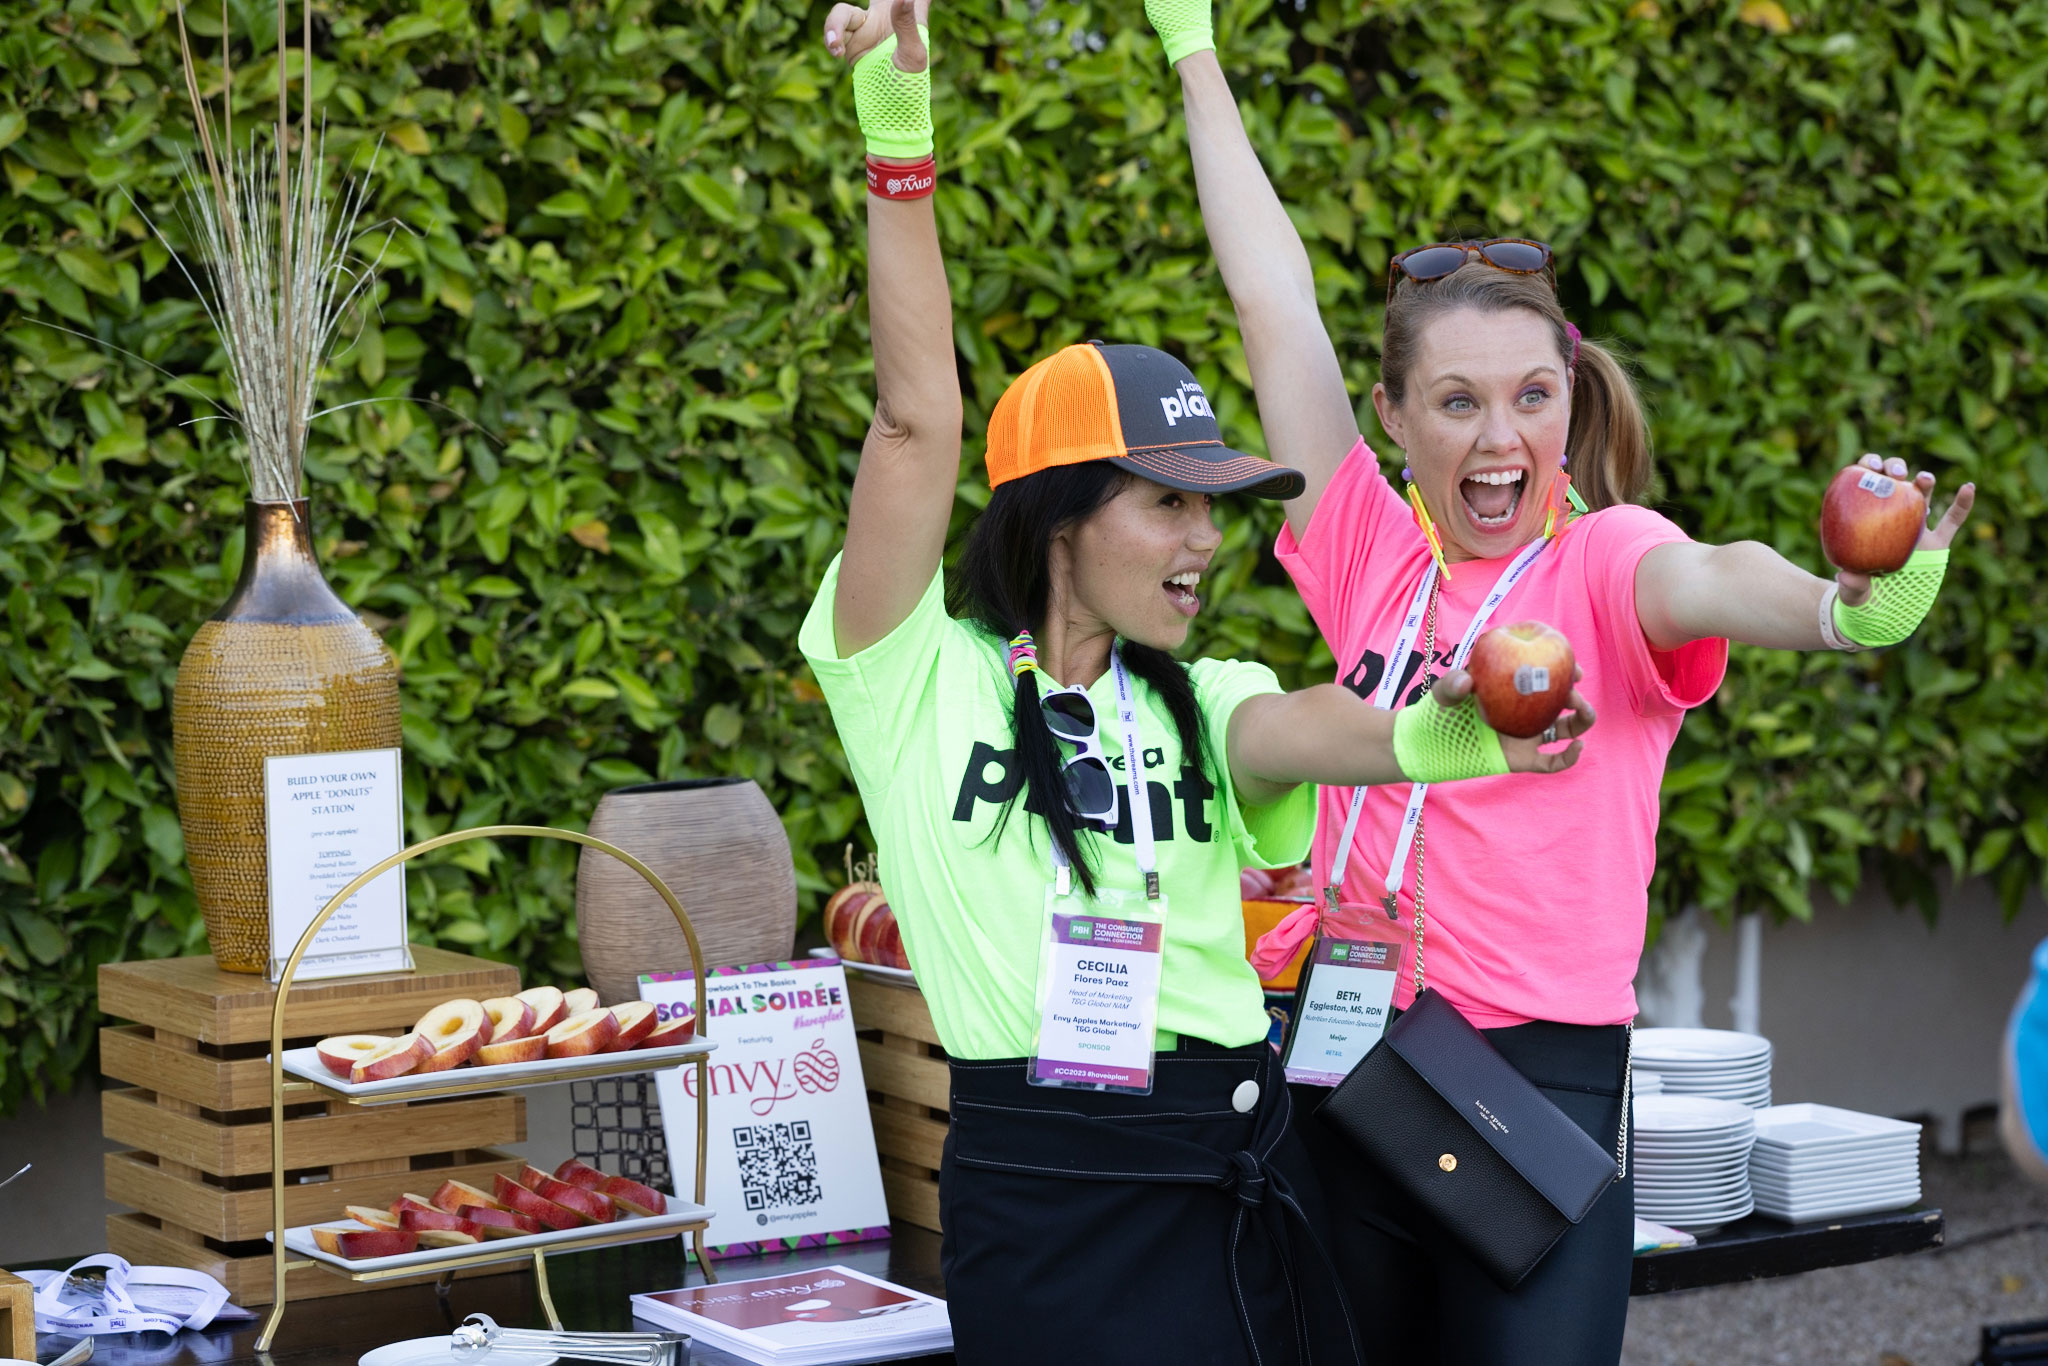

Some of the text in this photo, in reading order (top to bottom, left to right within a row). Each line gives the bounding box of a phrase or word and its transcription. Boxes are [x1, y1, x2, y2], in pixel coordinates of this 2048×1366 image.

[287, 771, 377, 786] BUILD YOUR OWN
[292, 791, 321, 801] APPLE
[311, 804, 355, 815] STATION
[318, 850, 351, 859] TOPPINGS
[1072, 922, 1144, 935] PBH THE CONSUMER
[1094, 929, 1143, 940] CONNECTION
[1349, 951, 1386, 960] CONNECTION
[1077, 960, 1128, 975] CECILIA
[694, 978, 796, 994] owback To The Basics
[1074, 973, 1129, 988] Flores Paez
[752, 982, 842, 1013] SOIRÉE
[1069, 989, 1133, 1003] Head of Marketing
[1336, 991, 1361, 1002] BETH
[1087, 998, 1113, 1009] Global
[1309, 1001, 1382, 1016] Eggleston, MS, RDN
[793, 1008, 845, 1031] #haveaplant
[1053, 1014, 1141, 1030] Envy Apples Marketing/
[1304, 1014, 1382, 1029] Nutrition Education Specialist
[1092, 1026, 1117, 1036] Global
[738, 1035, 773, 1047] Featuring
[1329, 1033, 1348, 1043] Meijer
[1078, 1042, 1111, 1051] SPONSOR
[1054, 1067, 1129, 1081] #CC2023 #haveaplant
[683, 1058, 797, 1116] envy
[1475, 1100, 1509, 1134] kate spade
[769, 1210, 818, 1223] @envyapples
[750, 1283, 824, 1296] envy
